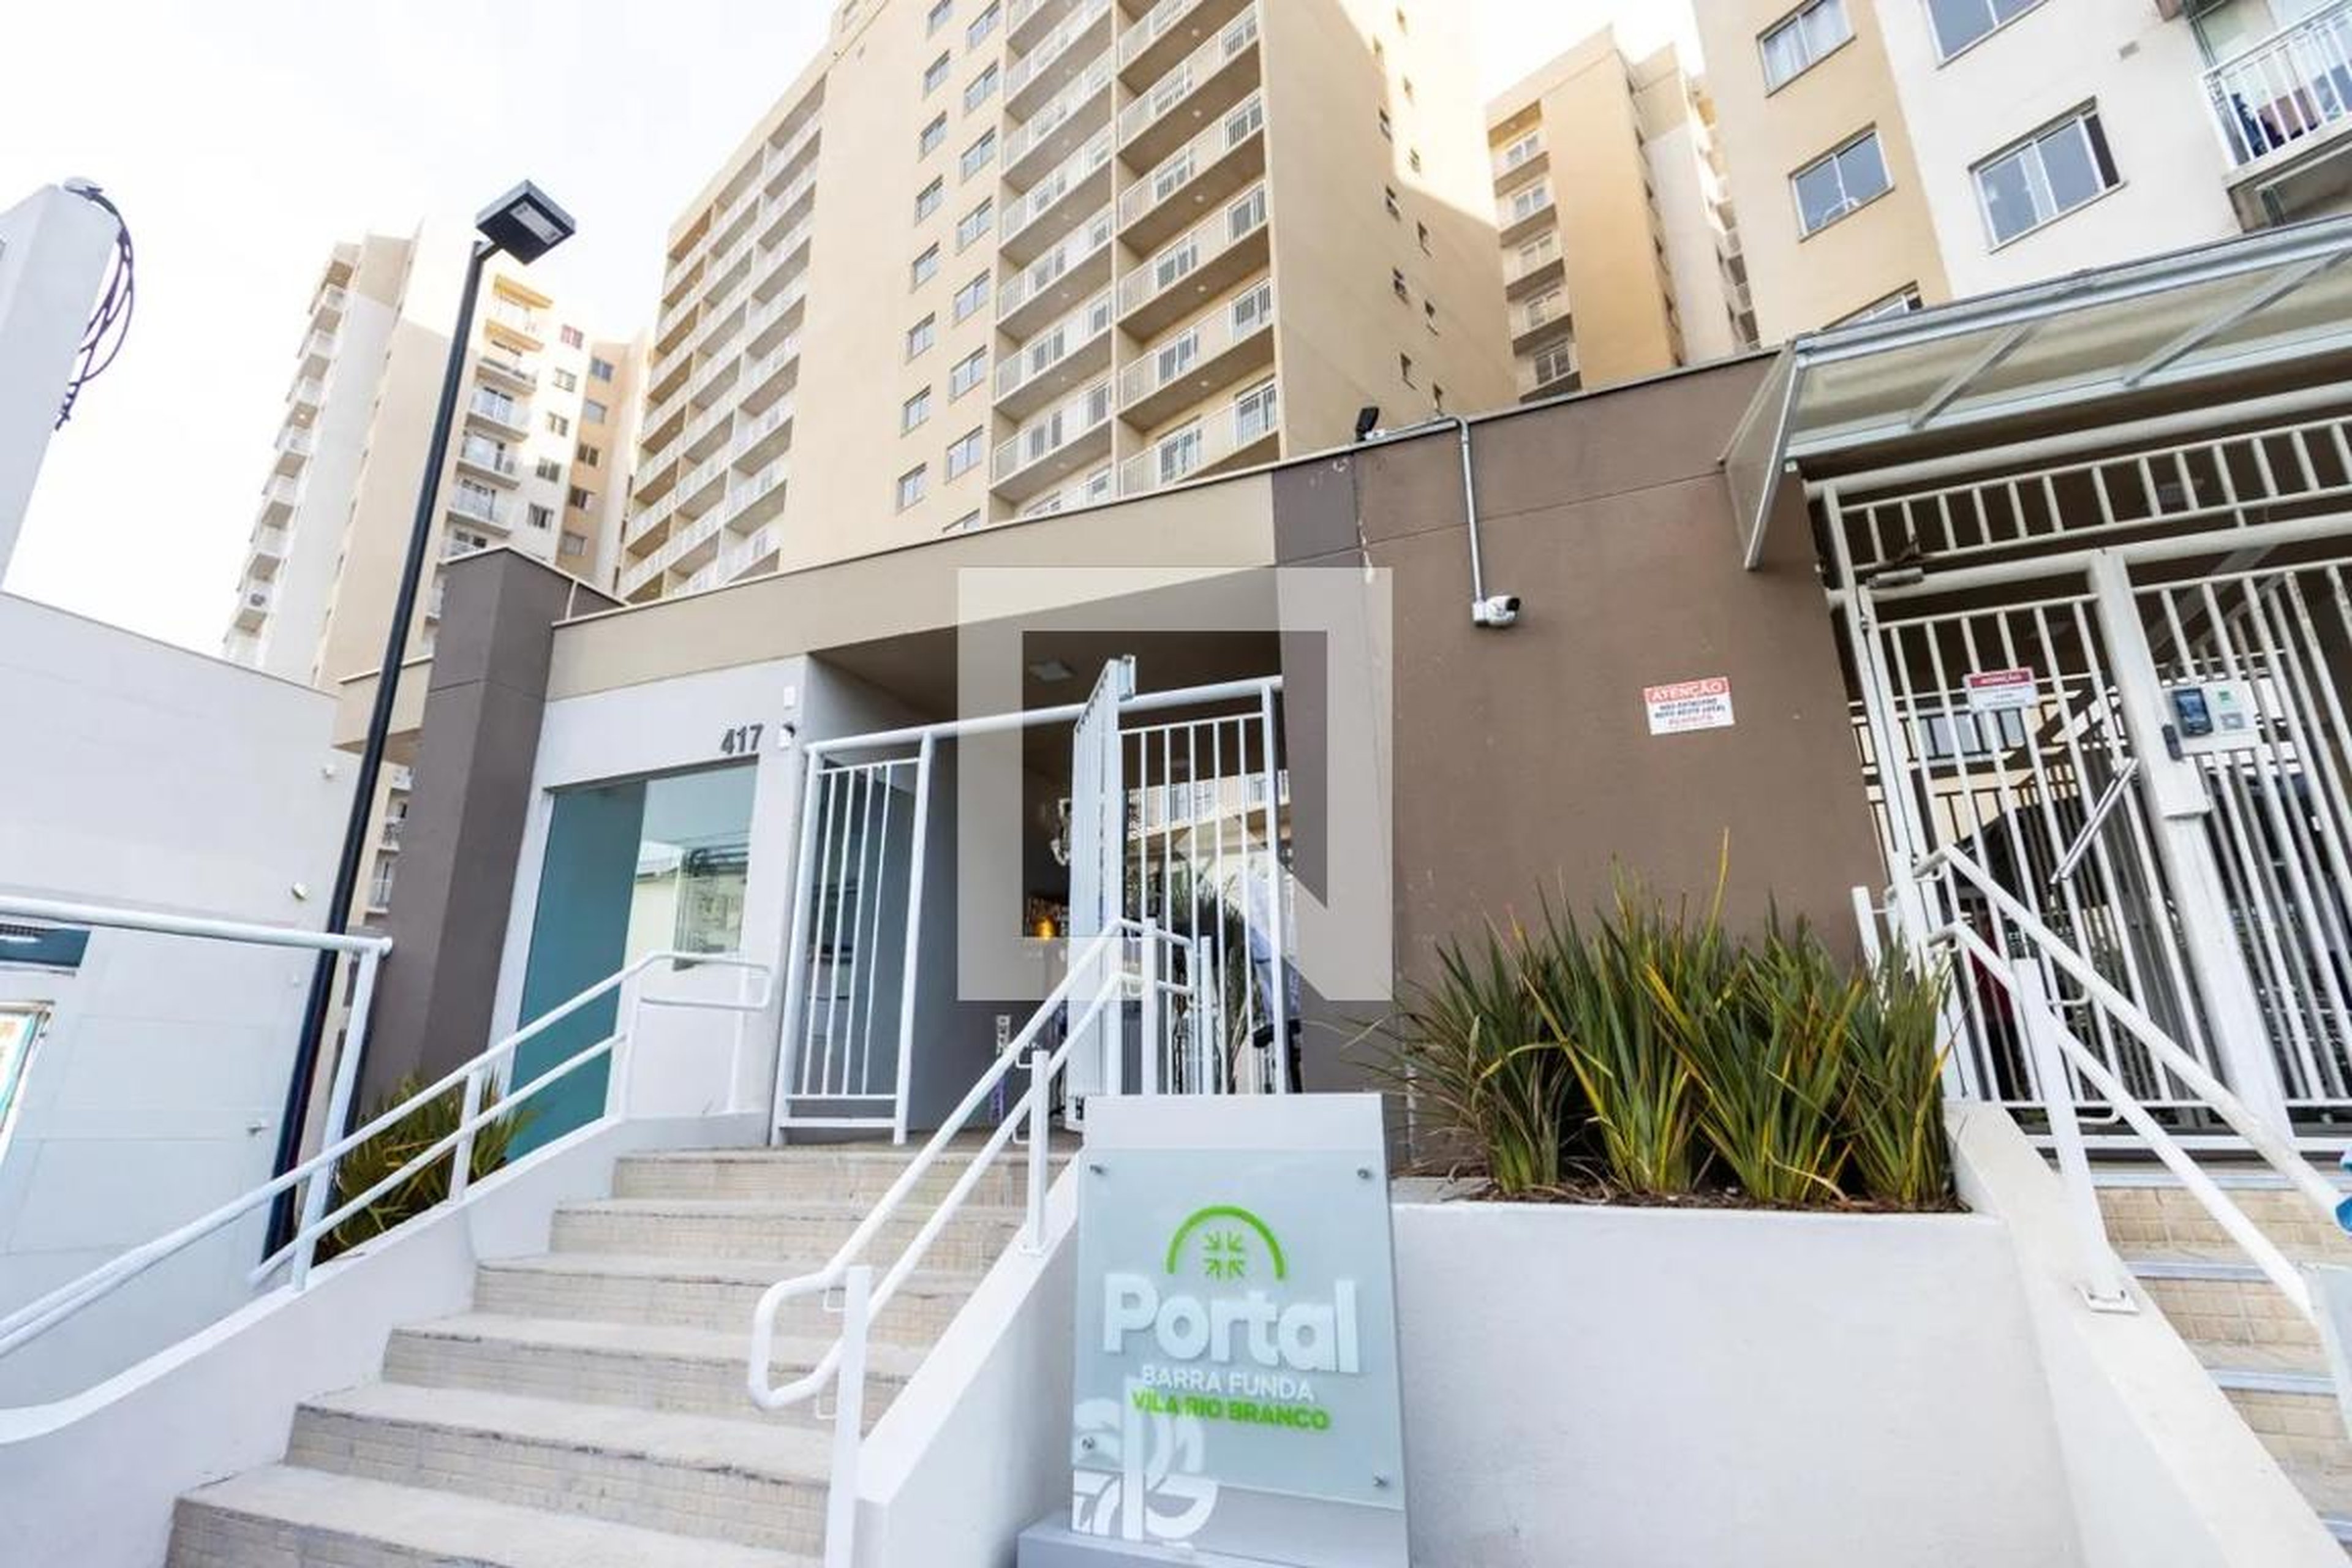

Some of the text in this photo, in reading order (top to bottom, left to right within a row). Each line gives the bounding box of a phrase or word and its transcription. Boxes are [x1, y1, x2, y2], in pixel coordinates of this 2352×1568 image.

[721, 724, 764, 754] 417
[1103, 1273, 1359, 1373] Portal
[1142, 1365, 1314, 1403] BARRA FUNDA
[1132, 1388, 1330, 1431] VILA RIO BRANCO
